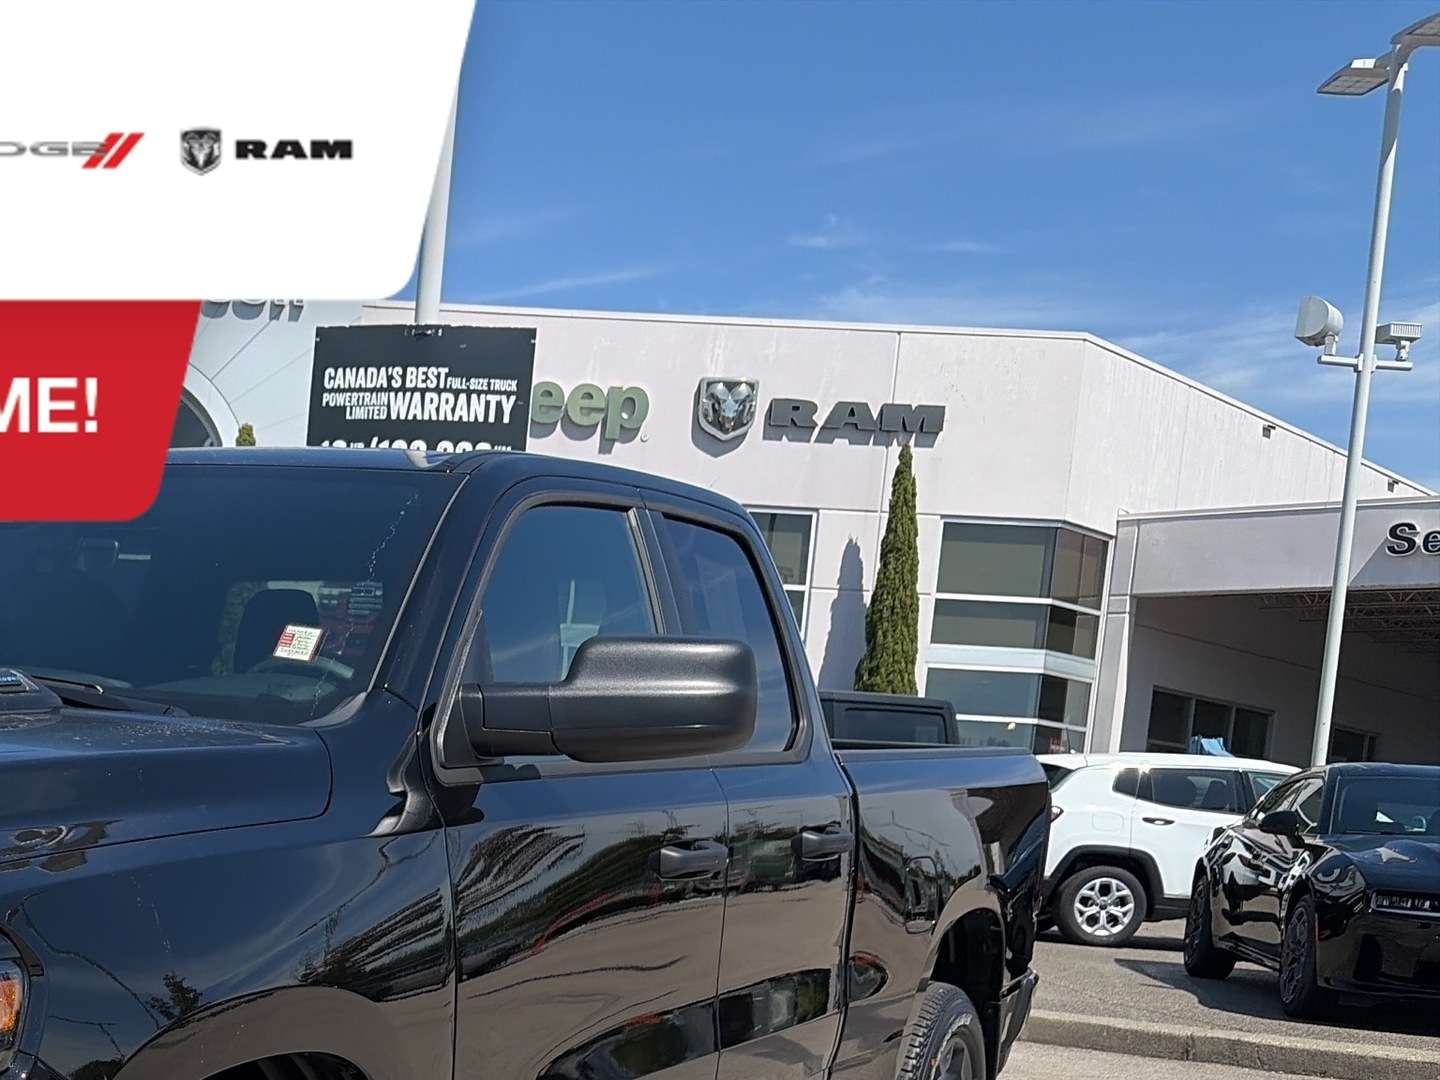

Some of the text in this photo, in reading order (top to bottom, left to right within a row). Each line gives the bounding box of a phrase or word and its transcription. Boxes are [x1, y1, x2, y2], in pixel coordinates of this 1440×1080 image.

[323, 366, 517, 392] CANADA'S BEST FULL-SIZE TRUCK
[322, 391, 388, 407] POWERTRAIN
[345, 405, 387, 420] LIMITED
[389, 391, 516, 424] WARRANTY
[531, 381, 650, 441] eep
[769, 398, 946, 433] RAM
